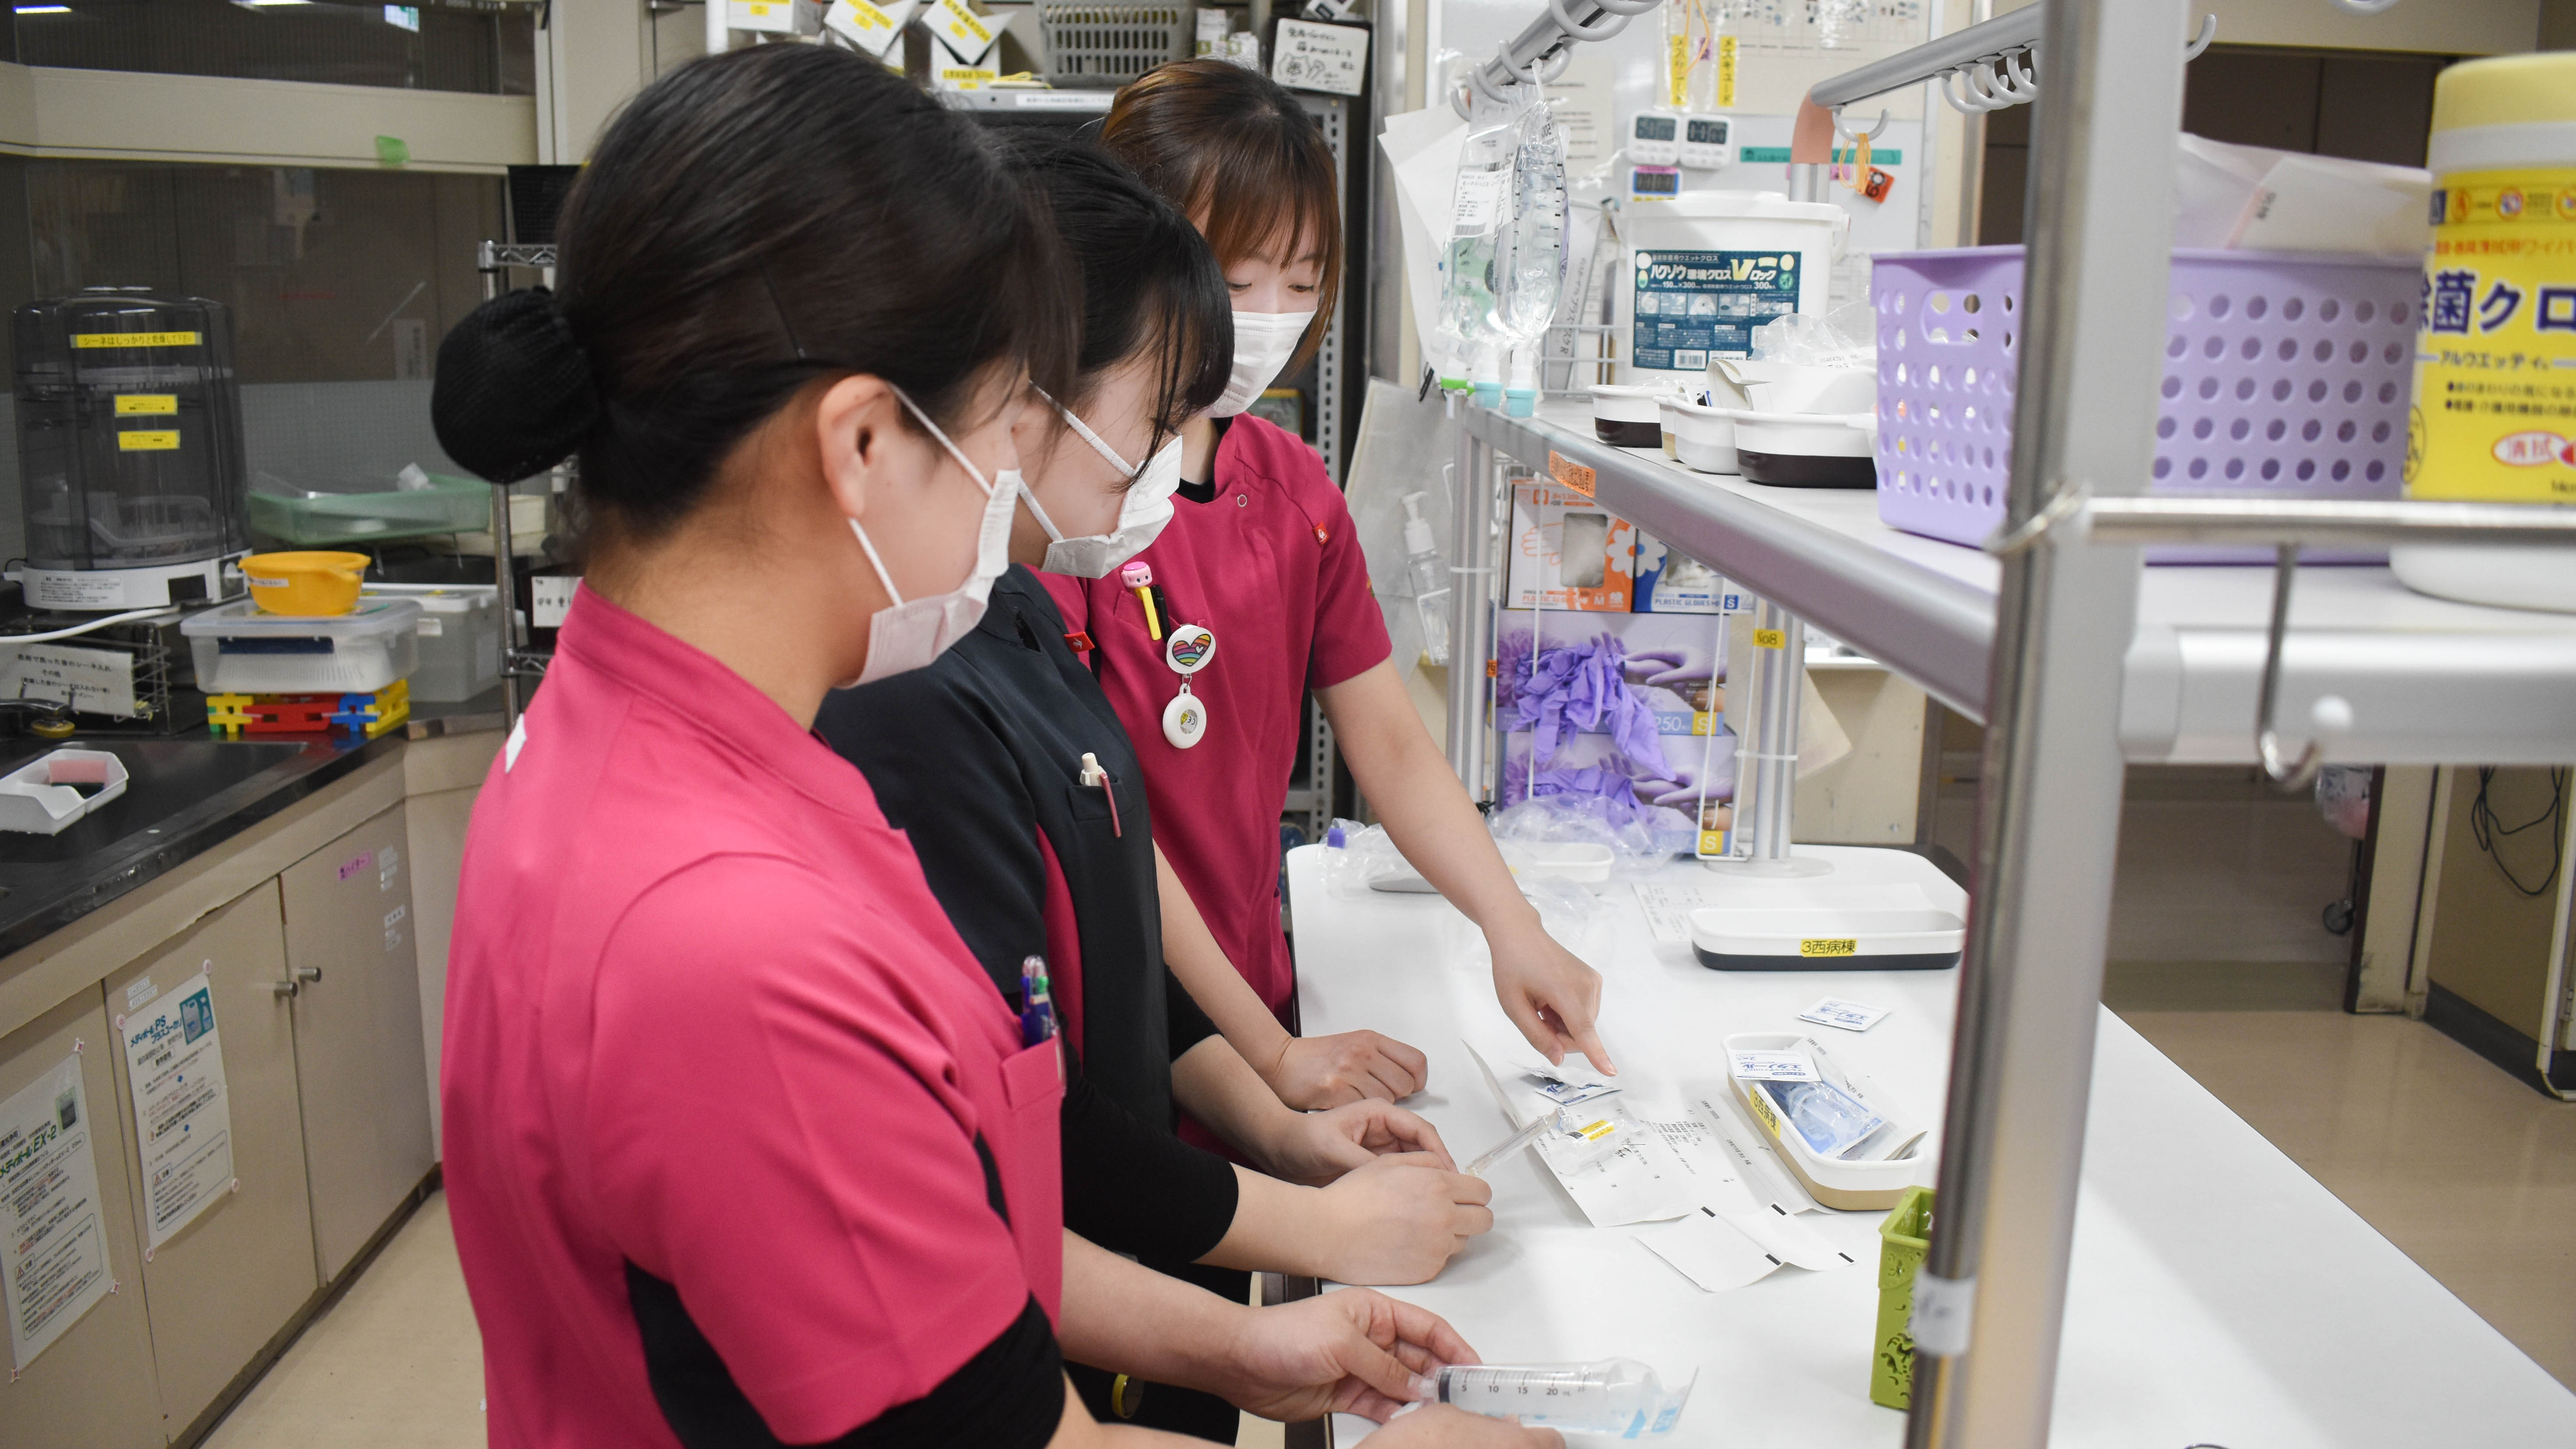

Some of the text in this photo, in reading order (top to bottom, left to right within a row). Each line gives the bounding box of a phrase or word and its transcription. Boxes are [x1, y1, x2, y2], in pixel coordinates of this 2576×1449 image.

[2421, 270, 2576, 334] 菌クロ
[1704, 835, 1716, 850] S
[1802, 940, 1856, 954] 3西病棟
